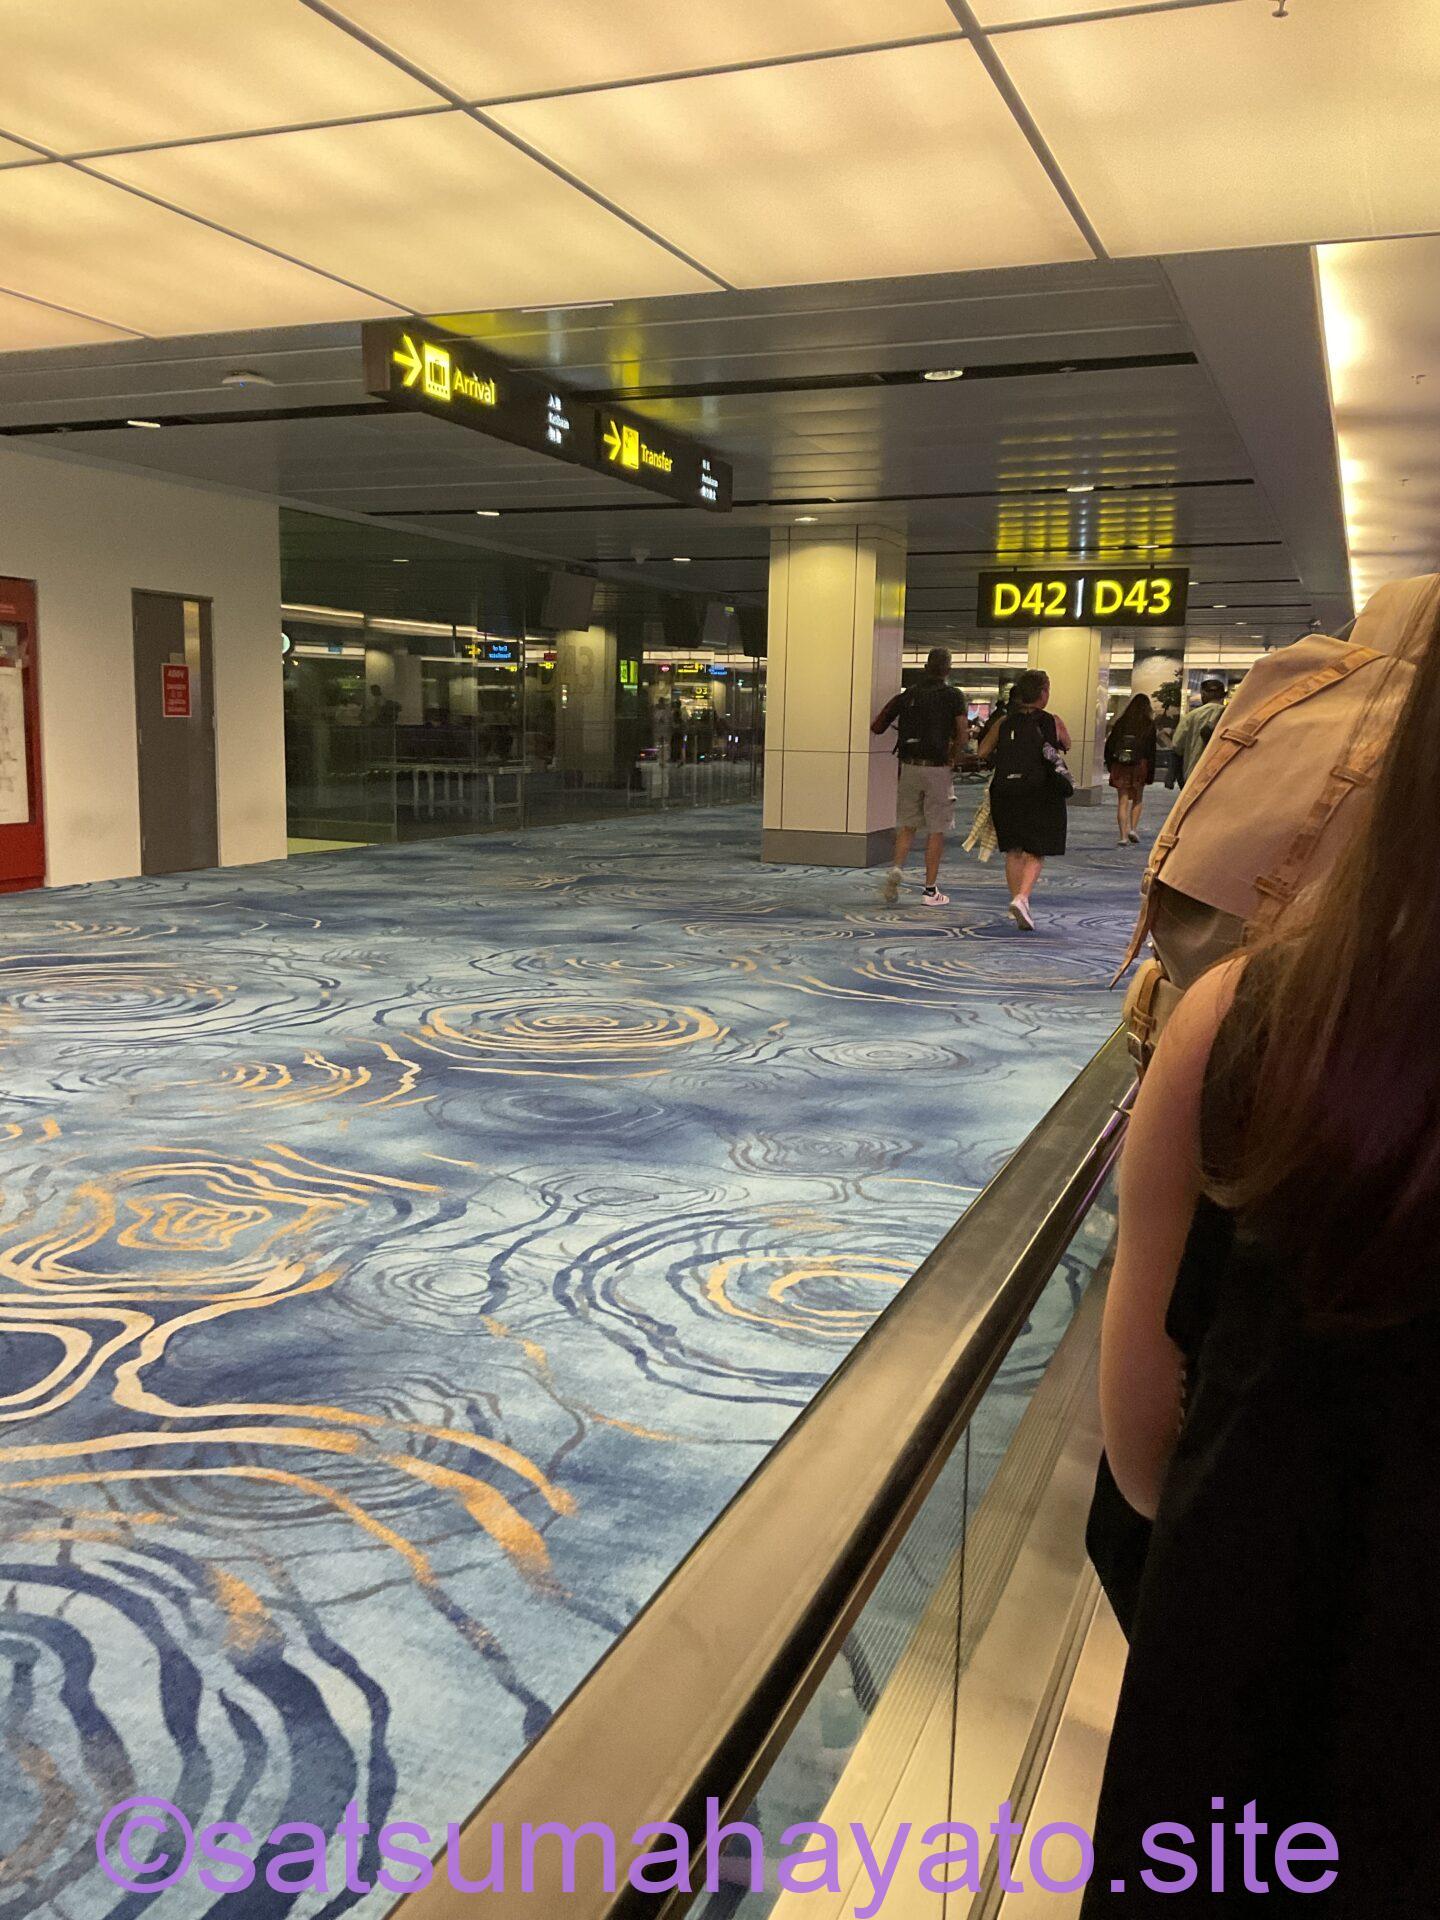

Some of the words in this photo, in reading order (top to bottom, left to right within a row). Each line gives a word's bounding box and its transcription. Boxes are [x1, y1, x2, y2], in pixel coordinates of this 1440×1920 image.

[454, 367, 496, 405] Arrival
[640, 444, 673, 471] Transfer
[994, 582, 1068, 616] D42
[1094, 578, 1172, 614] D43
